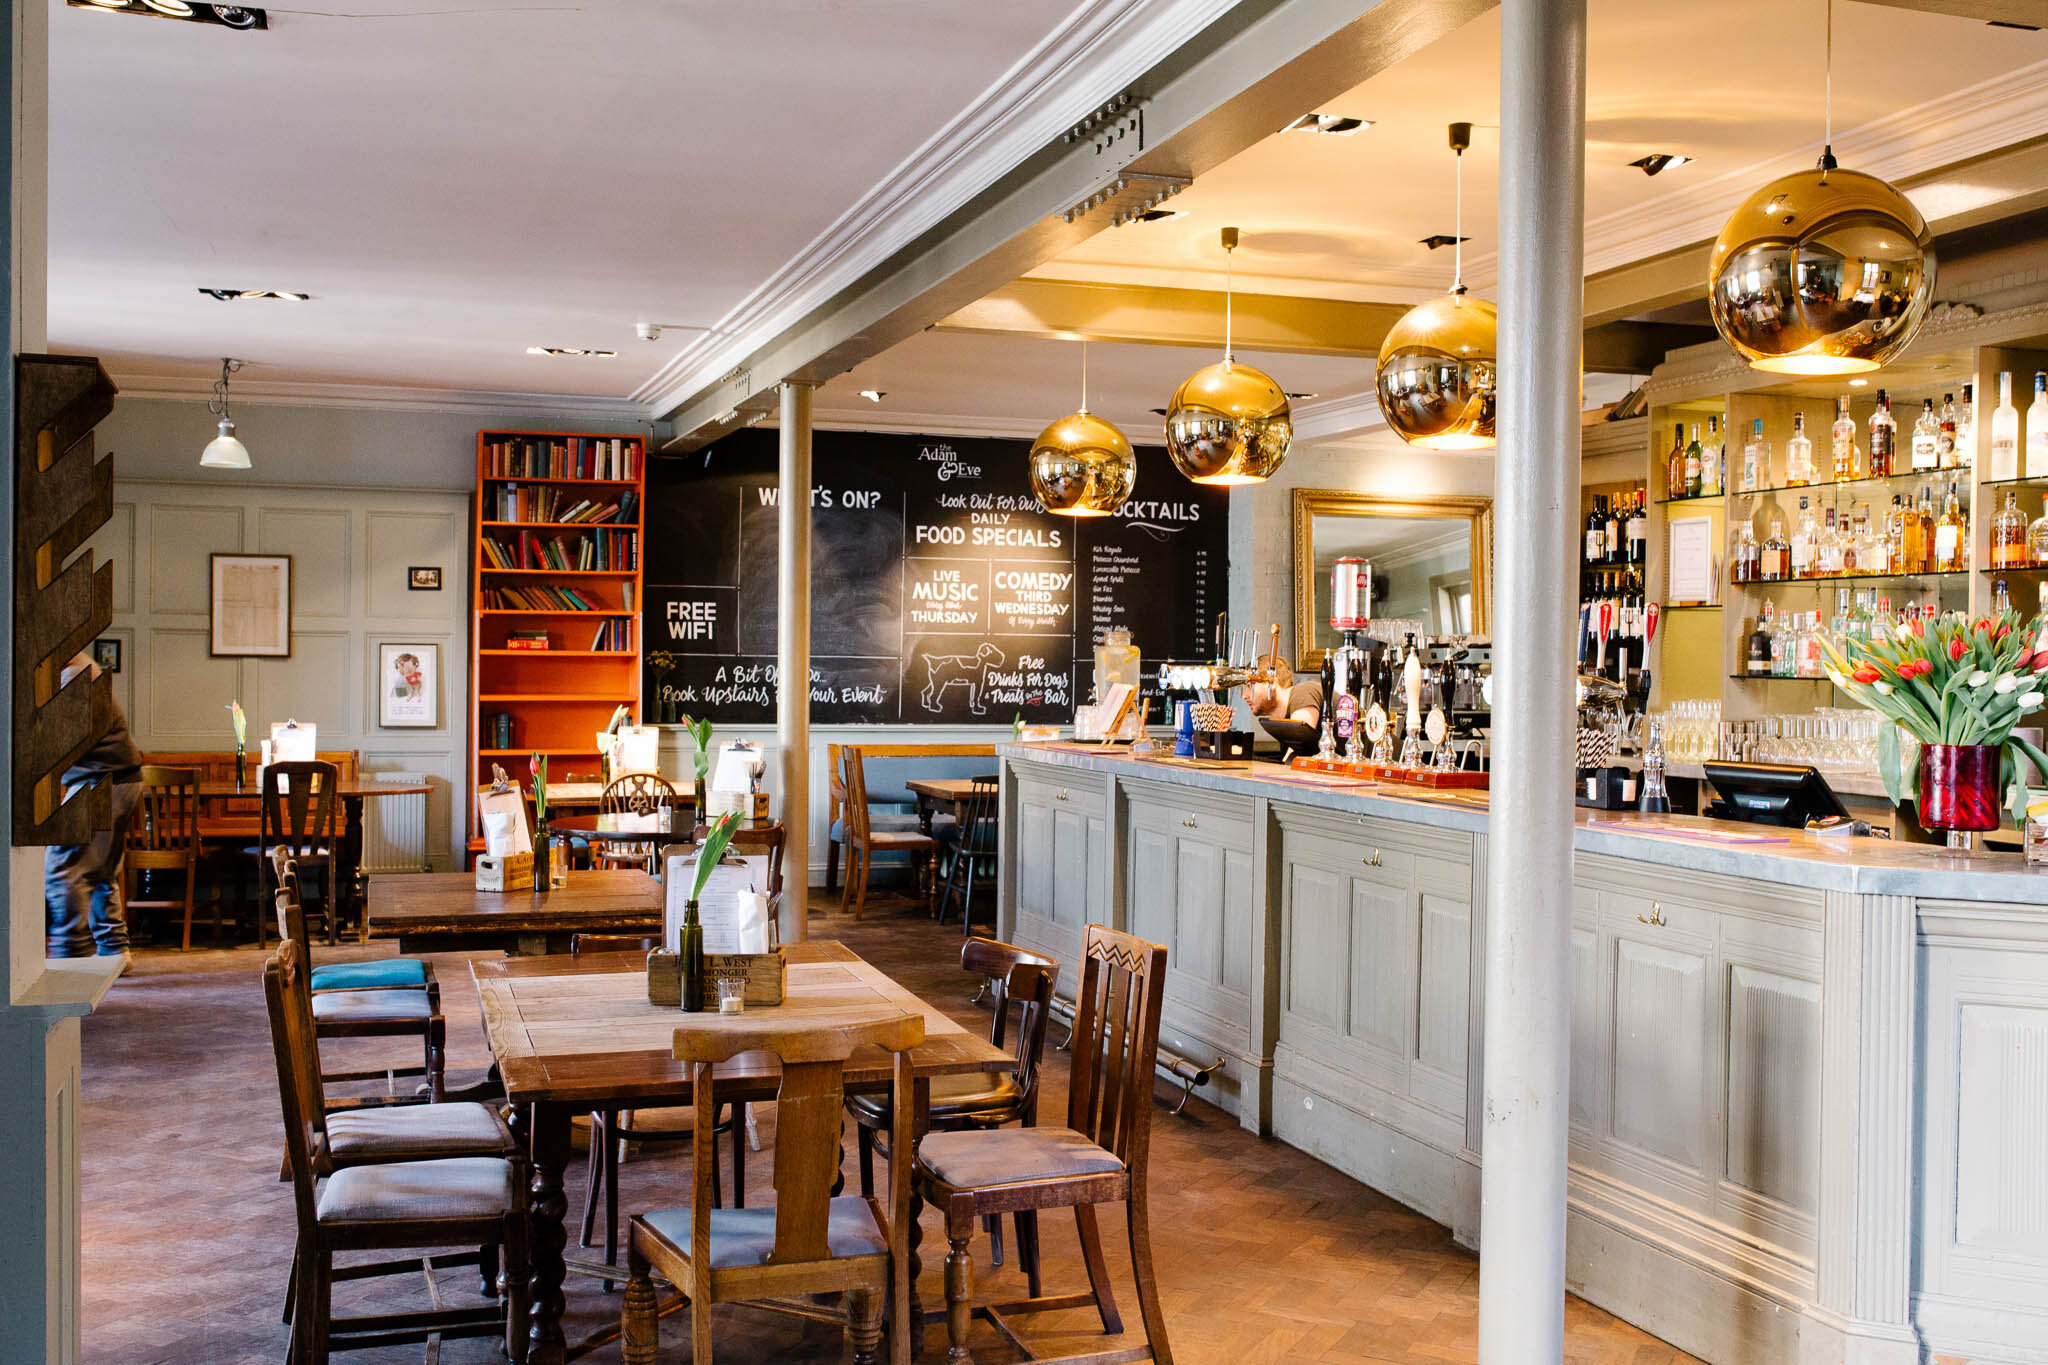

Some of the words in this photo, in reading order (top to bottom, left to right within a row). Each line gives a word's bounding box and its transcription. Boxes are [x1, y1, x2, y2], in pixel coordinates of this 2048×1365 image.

[918, 447, 957, 462] Adam
[958, 463, 982, 477] Eve
[758, 485, 833, 508] WT'S
[842, 490, 881, 509] ON?
[936, 493, 967, 508] Look
[970, 494, 994, 511] Out
[996, 496, 1016, 512] For
[971, 513, 1011, 525] DAILY
[1111, 501, 1200, 521] OCKTAILS
[916, 526, 966, 545] FOOD
[972, 528, 1062, 548] SPECIALS
[933, 570, 961, 582] LIVE
[995, 571, 1073, 591] COMEDY
[912, 582, 979, 601] MUSIC
[1016, 590, 1052, 602] THIRD
[666, 602, 717, 621] FREE
[911, 610, 979, 624] THURSDAY
[995, 602, 1070, 616] WEDNESDAY
[668, 622, 713, 640] WIFI
[1018, 655, 1046, 670] Free
[715, 666, 727, 683] A
[733, 664, 764, 684] Bit
[988, 671, 1024, 688] Drinks
[1026, 672, 1043, 686] For
[1044, 672, 1069, 690] Dogs
[701, 684, 769, 706] Upstairs
[841, 684, 887, 704] Event
[991, 688, 1025, 706] Treats
[1044, 688, 1069, 706] Bar
[723, 956, 754, 968] WEST
